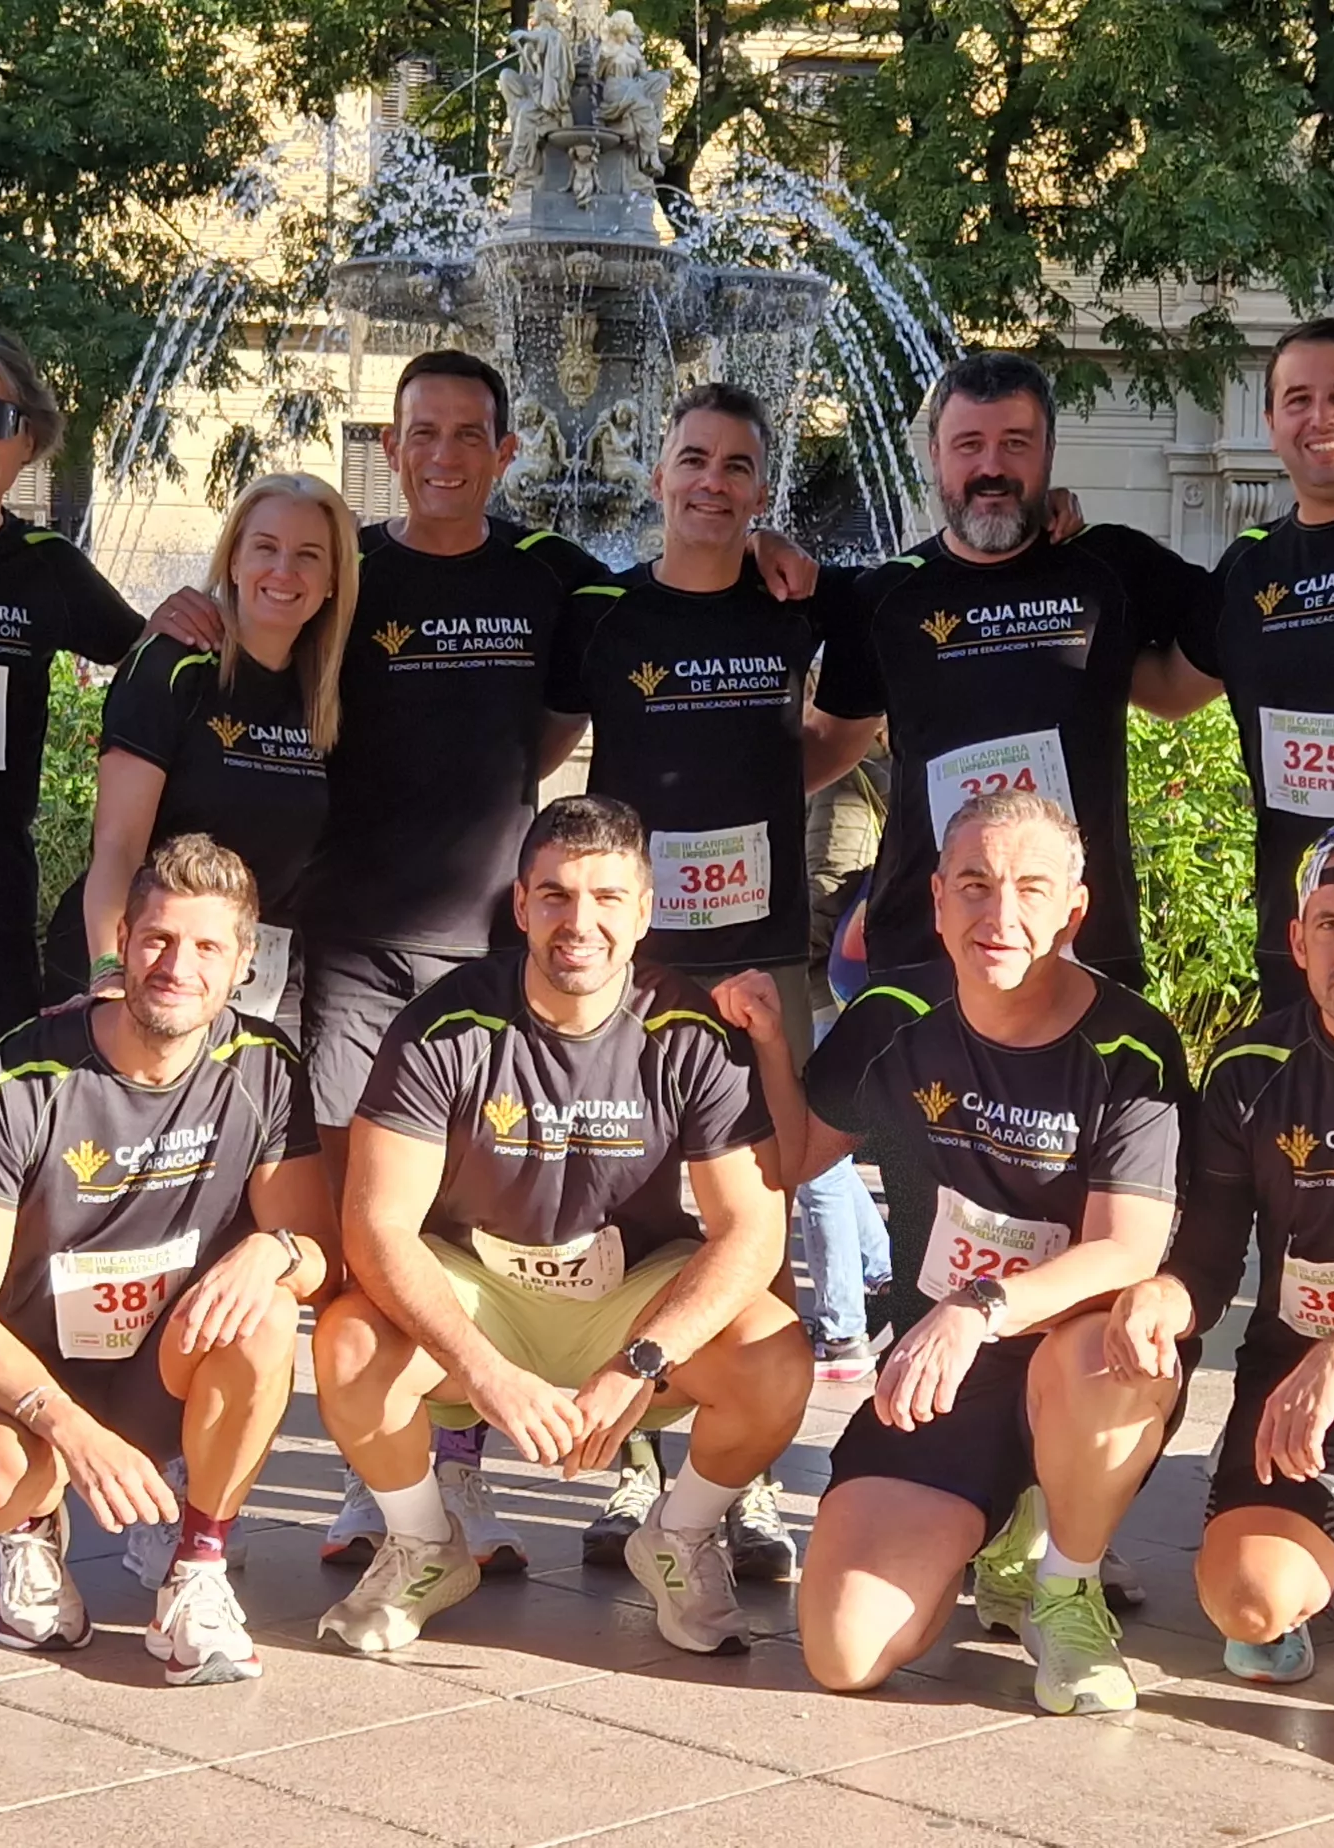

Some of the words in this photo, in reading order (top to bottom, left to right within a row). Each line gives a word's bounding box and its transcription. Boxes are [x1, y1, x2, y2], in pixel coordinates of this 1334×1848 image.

[967, 604, 1016, 624] CAJA
[1019, 597, 1084, 619] RURAL
[1304, 595, 1324, 609] DE
[421, 618, 470, 636] CAJA
[475, 617, 532, 634] RURAL
[981, 625, 1002, 638] DE
[1006, 617, 1072, 635] ARAGÓN
[436, 639, 457, 652] DE
[462, 636, 524, 650] ARAGÓN
[675, 659, 725, 677] CAJA
[729, 656, 786, 674] RURAL
[691, 679, 712, 692] DE
[717, 676, 780, 690] ARAGÓN
[248, 724, 282, 742] CAJA
[261, 743, 276, 756] DE
[971, 744, 1028, 761] CARRERA
[1291, 789, 1310, 805] 8K
[680, 859, 748, 894] 384
[659, 897, 697, 910] LUIS
[703, 888, 765, 909] IGNACIO
[689, 911, 714, 925] 8K
[574, 1100, 644, 1119] RURAL
[1010, 1106, 1080, 1133] RURAL
[159, 1123, 218, 1151] RURAL
[542, 1128, 566, 1142] DE
[992, 1127, 1063, 1150] ARAGÓN
[144, 1147, 206, 1171] ARAGÓN
[508, 1257, 588, 1278] 107
[949, 1237, 1031, 1280] 326
[93, 1273, 166, 1313] 381
[114, 1311, 154, 1331] LUIS
[106, 1333, 133, 1348] 8K
